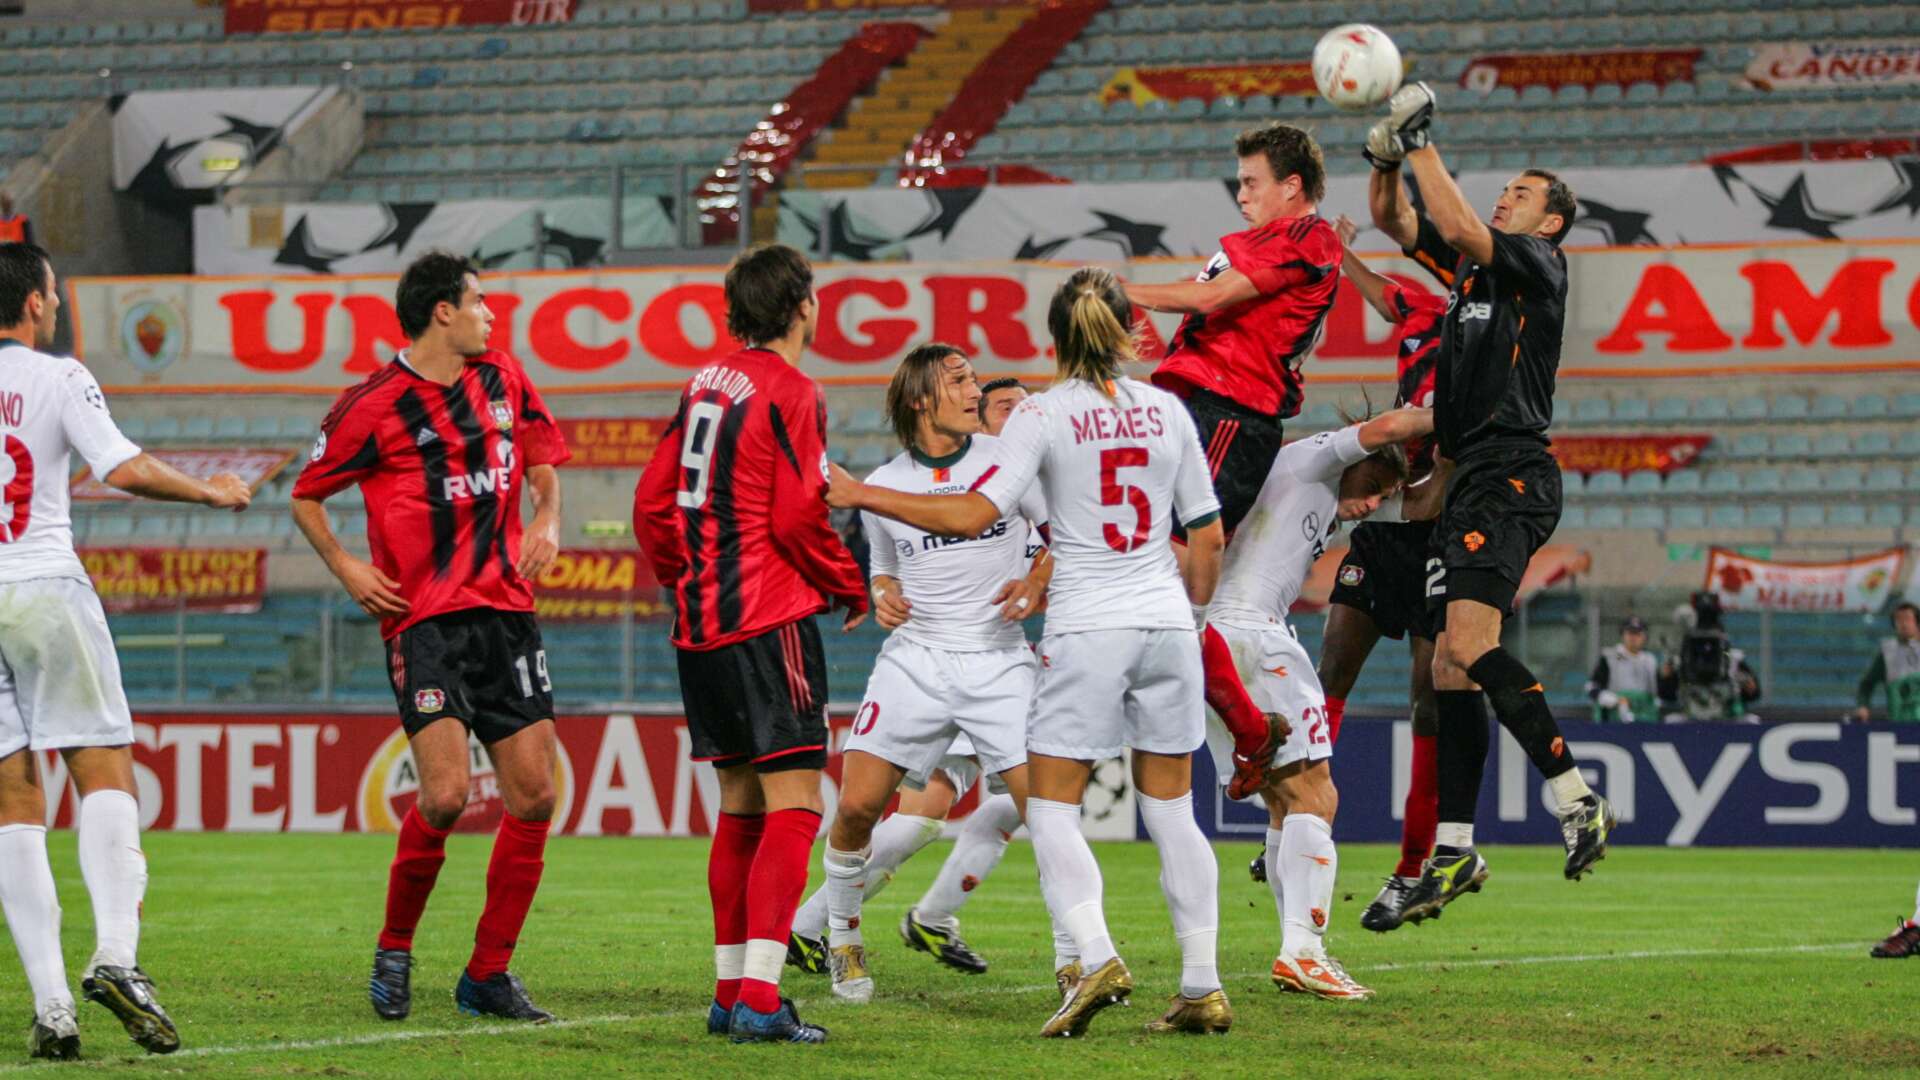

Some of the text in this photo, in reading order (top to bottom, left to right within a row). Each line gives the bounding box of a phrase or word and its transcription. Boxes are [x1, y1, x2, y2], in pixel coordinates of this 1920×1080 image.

[265, 7, 464, 32] SENSI
[1594, 257, 1920, 354] AM
[690, 366, 757, 405] BERBATOV
[1070, 406, 1164, 445] MEXES
[676, 401, 724, 509] 9
[443, 467, 511, 501] RWE
[1100, 447, 1152, 554] 5
[539, 556, 636, 590] OMA
[515, 650, 552, 698] 19
[1391, 720, 1920, 846] laySt
